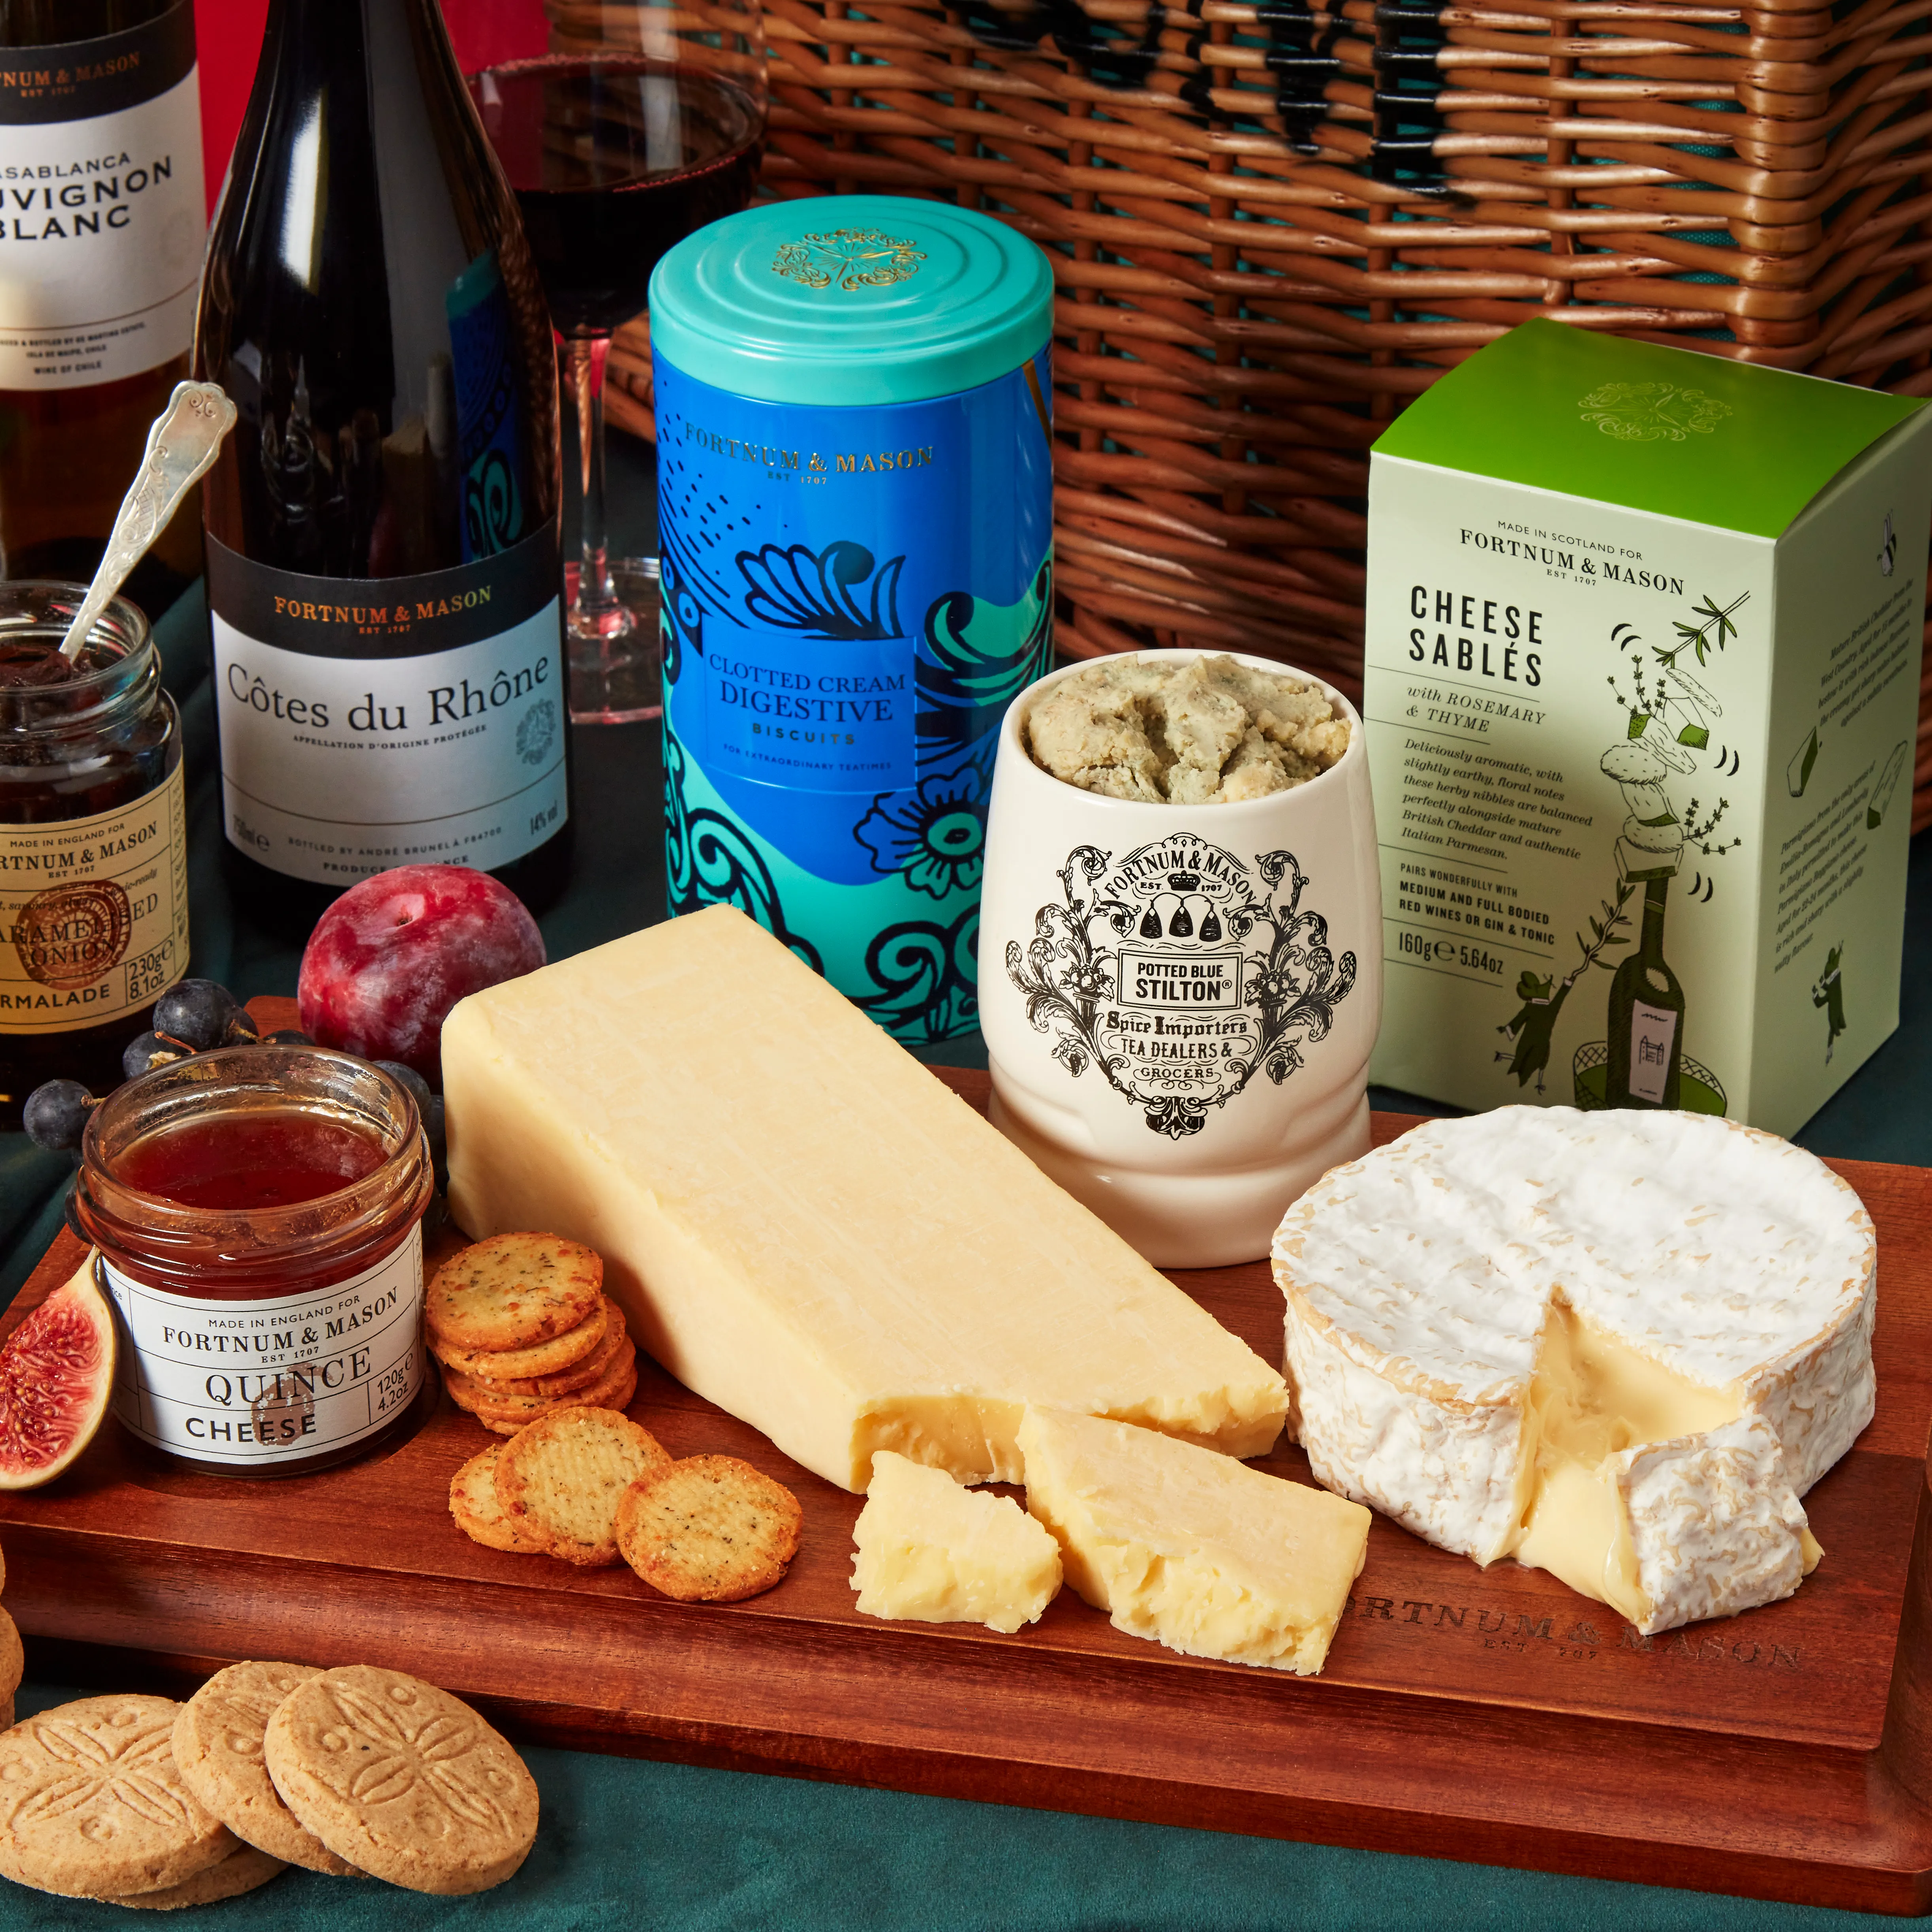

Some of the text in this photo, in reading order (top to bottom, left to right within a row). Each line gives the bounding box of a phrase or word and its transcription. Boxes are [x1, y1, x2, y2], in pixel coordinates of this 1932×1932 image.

[76, 51, 140, 82] MASON
[685, 421, 933, 473] FORTNUM & MASON
[768, 471, 827, 485] EST 1707
[1498, 520, 1643, 560] MADE IN SCOTLAND FOR
[1460, 528, 1684, 596] FORTNUM & MASON
[1546, 569, 1597, 586] EST 1707
[274, 586, 491, 624] FORTNUM & MASON
[1411, 586, 1543, 645] CHEESE
[710, 653, 906, 693] CLOTTED CREAM
[1409, 628, 1541, 687] SABLÉS
[227, 656, 549, 731] Côtes du Rhône
[720, 680, 893, 722] DIGESTIVE
[1407, 686, 1546, 724] with ROSEMARY
[752, 723, 855, 745] BISCUITS
[1406, 705, 1490, 732] & THYME
[293, 724, 487, 750] APPELLATION D'ORIGINE PROTÉGÉE
[724, 743, 892, 771] FOR EXTRAORDINARY TEATIMES
[1405, 738, 1564, 783] Deliciously aromatic, with
[1405, 755, 1564, 802] slightly earthy, floral notes
[1402, 790, 1561, 837] perfectly alongside mature
[1404, 774, 1592, 827] these herby nibbles are balanced
[58, 830, 104, 845] ENGLAND
[108, 823, 125, 835] FOR
[81, 849, 94, 864] &
[99, 820, 157, 860] MASON
[288, 837, 335, 853] BOTTLED
[359, 846, 399, 856] ANDRÉ
[404, 843, 449, 855] BRUNEL
[1401, 826, 1507, 861] Italian Parmesan.
[1402, 808, 1581, 860] British Cheddar and authentic
[48, 865, 95, 879] EST 1707
[1104, 850, 1257, 904] FORTNUM & MASON
[1140, 882, 1164, 890] EST.
[1401, 862, 1517, 898] PAIRS WONDERFULLY WITH
[1400, 880, 1549, 925] MEDIUM AND FULL BODIED
[1399, 898, 1554, 945] RED WINES OR GIN & TONIC
[31, 938, 115, 967] ONION
[1138, 962, 1224, 978] POTTED BLUE
[1460, 945, 1503, 975] 5.64oz
[130, 971, 165, 1000] 8.1oz
[1106, 1011, 1247, 1039] Spice Importers
[1121, 1038, 1232, 1059] TEA DEALERS &
[1140, 1068, 1214, 1078] GROCERS
[162, 1286, 397, 1353] FORTNUM & MASON
[209, 1295, 360, 1328] MADE IN ENGLAND FOR
[261, 1346, 319, 1363] EST 1707
[206, 1346, 372, 1406] QUINCE
[377, 1380, 409, 1412] 4.2oz
[185, 1413, 317, 1443] CHEESE
[1568, 1622, 1601, 1644] &
[1616, 1626, 1804, 1667] MASON
